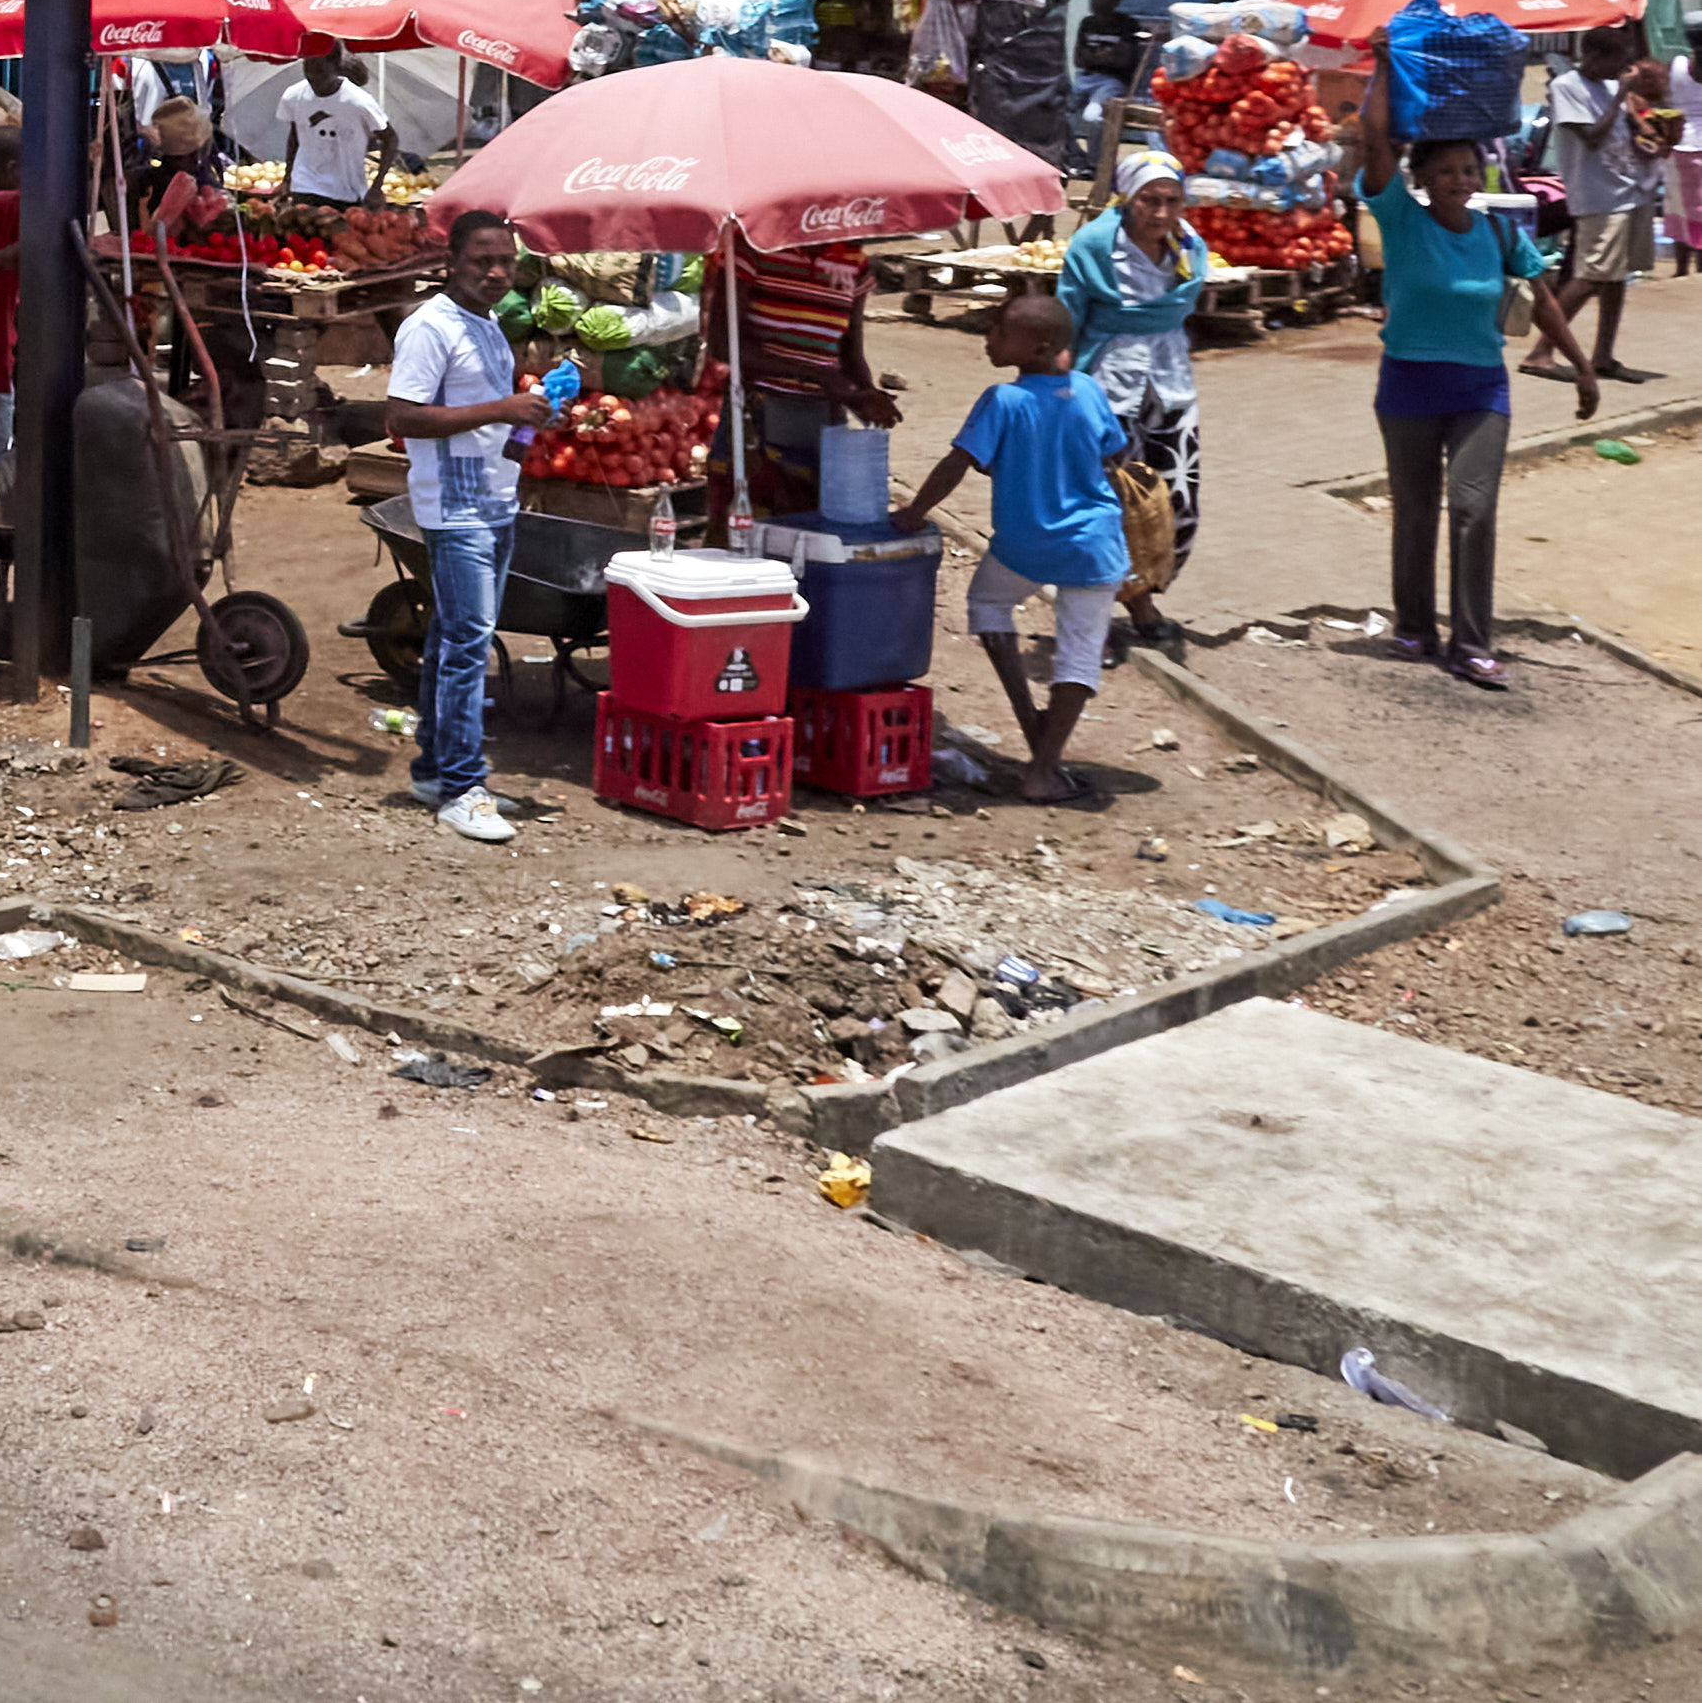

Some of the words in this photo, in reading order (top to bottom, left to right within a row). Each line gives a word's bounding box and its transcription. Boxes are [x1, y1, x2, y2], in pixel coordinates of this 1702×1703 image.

[100, 21, 166, 44] Coca-Cola
[458, 30, 520, 64] Coca-Cola
[563, 156, 700, 193] Coca-Cola
[801, 198, 889, 233] Coca-Cola
